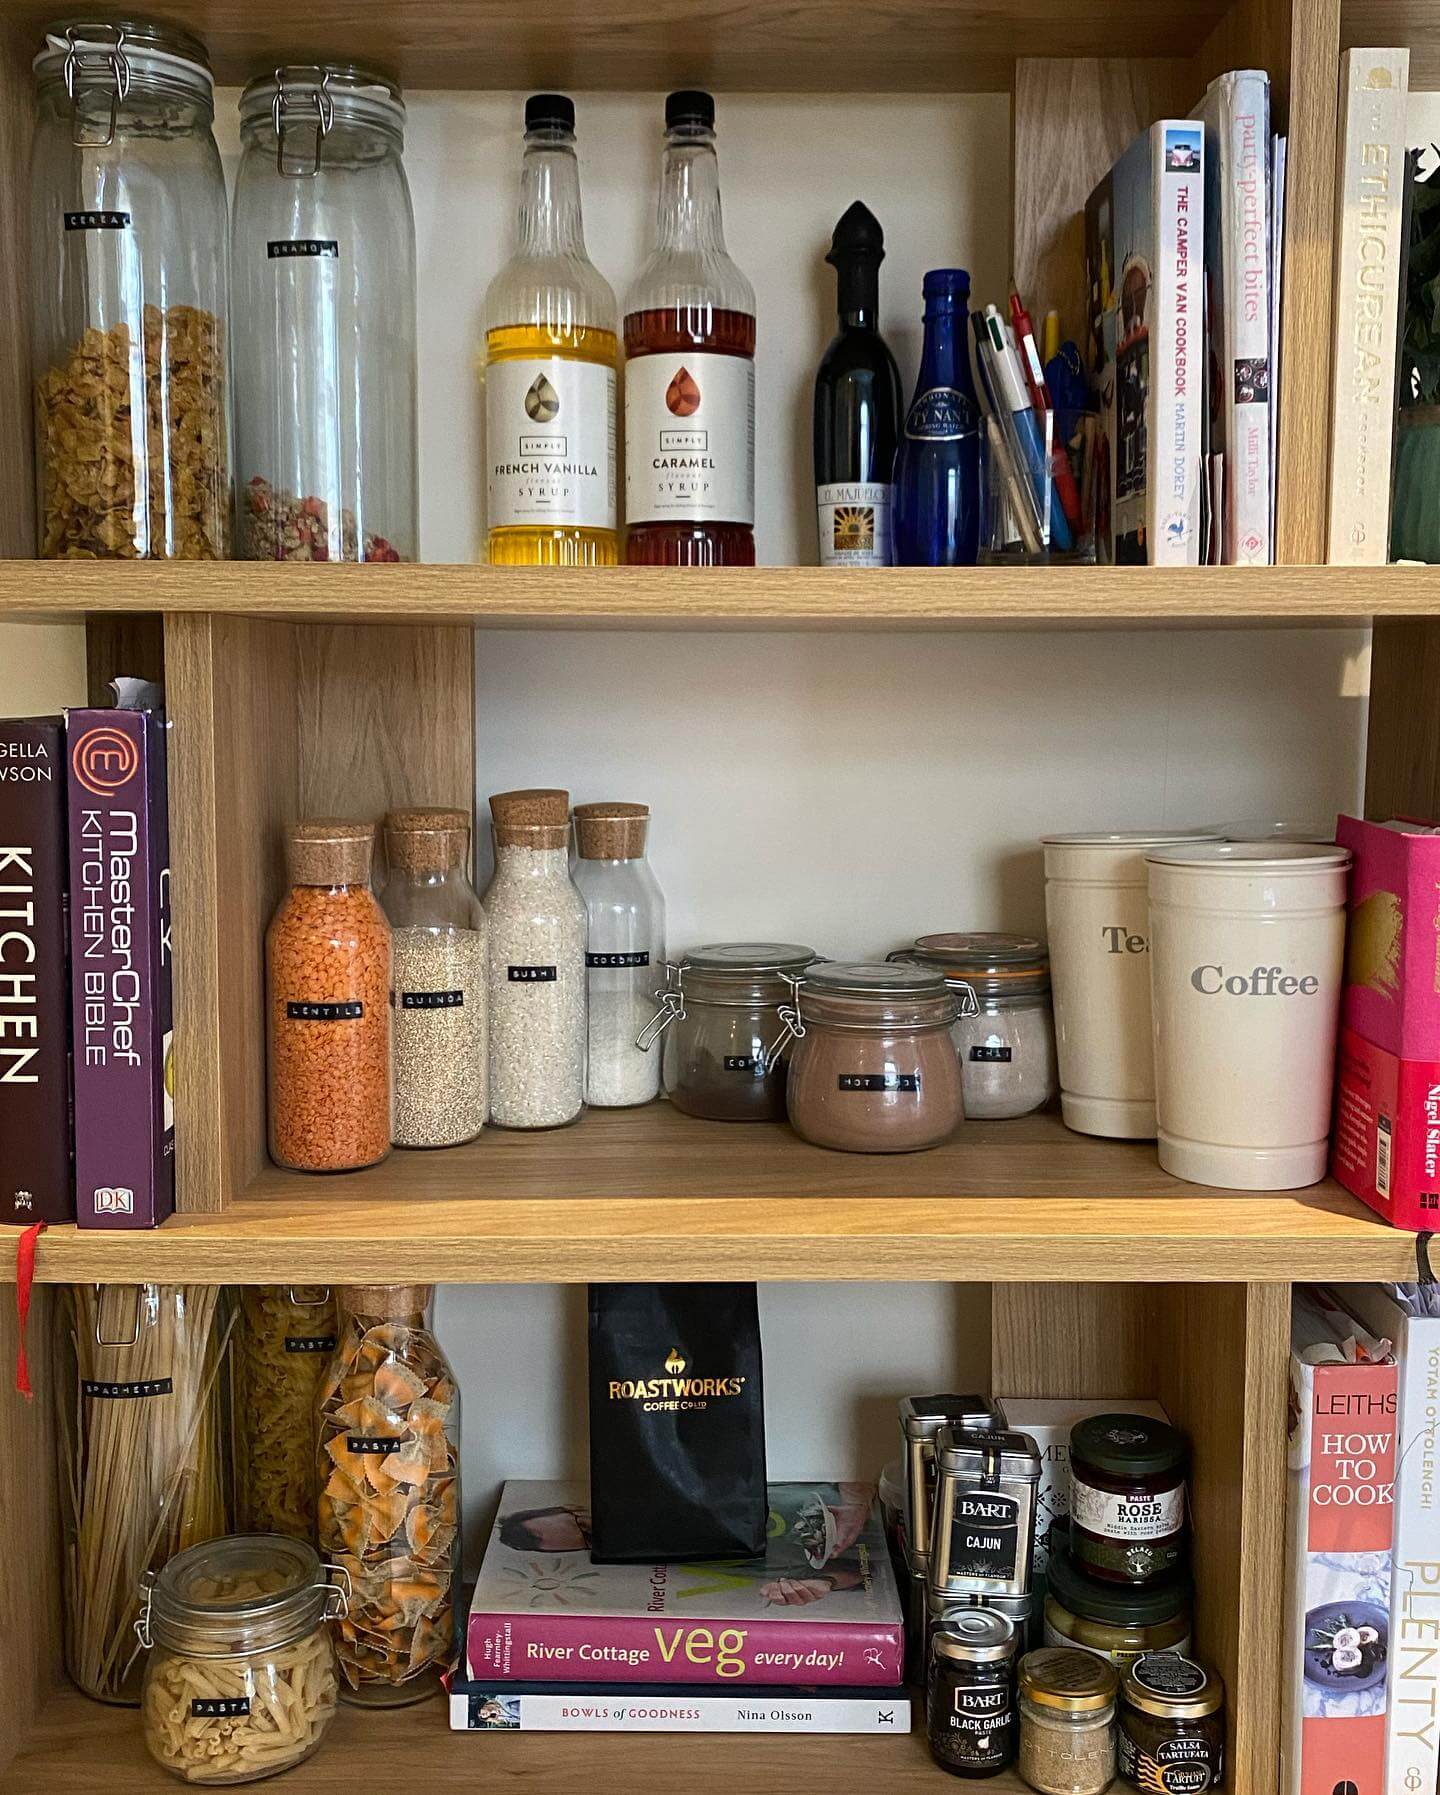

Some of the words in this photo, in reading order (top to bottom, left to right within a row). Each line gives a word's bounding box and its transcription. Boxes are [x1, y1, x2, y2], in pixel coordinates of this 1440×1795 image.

[1235, 114, 1262, 261] party-perfect
[1176, 186, 1189, 213] THE
[1175, 217, 1188, 278] CAMPER
[1352, 143, 1390, 404] ETHICUREAN
[1175, 283, 1188, 314] VAN
[1244, 268, 1263, 322] bites
[1174, 320, 1187, 396] COOKBOOK
[1174, 403, 1185, 452] MARTIN
[495, 463, 539, 476] FRENCH
[544, 463, 598, 476] VANILLA
[652, 458, 715, 469] CARAMEL
[659, 483, 709, 492] SYRUP
[1173, 457, 1185, 500] DOREY
[519, 487, 569, 497] SYRUP
[81, 811, 105, 958] KITCHEN
[110, 810, 141, 1066] MasterChef
[1102, 926, 1149, 953] Te
[0, 847, 40, 1083] KITCHEN
[593, 954, 648, 964] COCONUT
[513, 969, 555, 978] SUSHI
[1191, 965, 1319, 996] Coffee
[292, 1006, 361, 1016] LENTILS
[406, 995, 461, 1005] QUINOA
[84, 972, 106, 1066] BIBLE
[1425, 1127, 1440, 1178] Slater
[98, 1191, 128, 1208] DK
[1426, 1346, 1440, 1400] YOTAM
[86, 1382, 170, 1394] SPAGHETTI
[609, 1378, 741, 1399] ROASTWORKS
[643, 1401, 679, 1412] COFFEE
[1316, 1393, 1397, 1415] LEITHS
[352, 1441, 399, 1451] PASTA
[1321, 1433, 1392, 1455] HOW
[1420, 1406, 1437, 1510] OTTOLENGHI
[1335, 1459, 1376, 1480] TO
[1312, 1484, 1394, 1506] COOK
[960, 1501, 1011, 1519] BART
[1117, 1502, 1162, 1517] ROSE
[966, 1535, 1001, 1550] CAJUN
[484, 1637, 493, 1660] Hugh
[503, 1622, 512, 1674] Whittingstall
[527, 1643, 574, 1659] River
[579, 1645, 650, 1665] Cottage
[654, 1627, 748, 1677] veg
[1397, 1561, 1440, 1751] PLENTY
[196, 1701, 248, 1712] PASTA
[962, 1692, 1004, 1708] BART
[562, 1708, 608, 1718] BOWLS
[613, 1708, 625, 1720] of
[629, 1709, 700, 1719] GOODNESS
[737, 1709, 766, 1721] Nina
[770, 1710, 812, 1721] Olsson
[950, 1716, 981, 1730] BLACK
[983, 1712, 1012, 1730] GARLIC
[1159, 1750, 1209, 1760] TARTUFATA
[1169, 1741, 1200, 1751] SALSA
